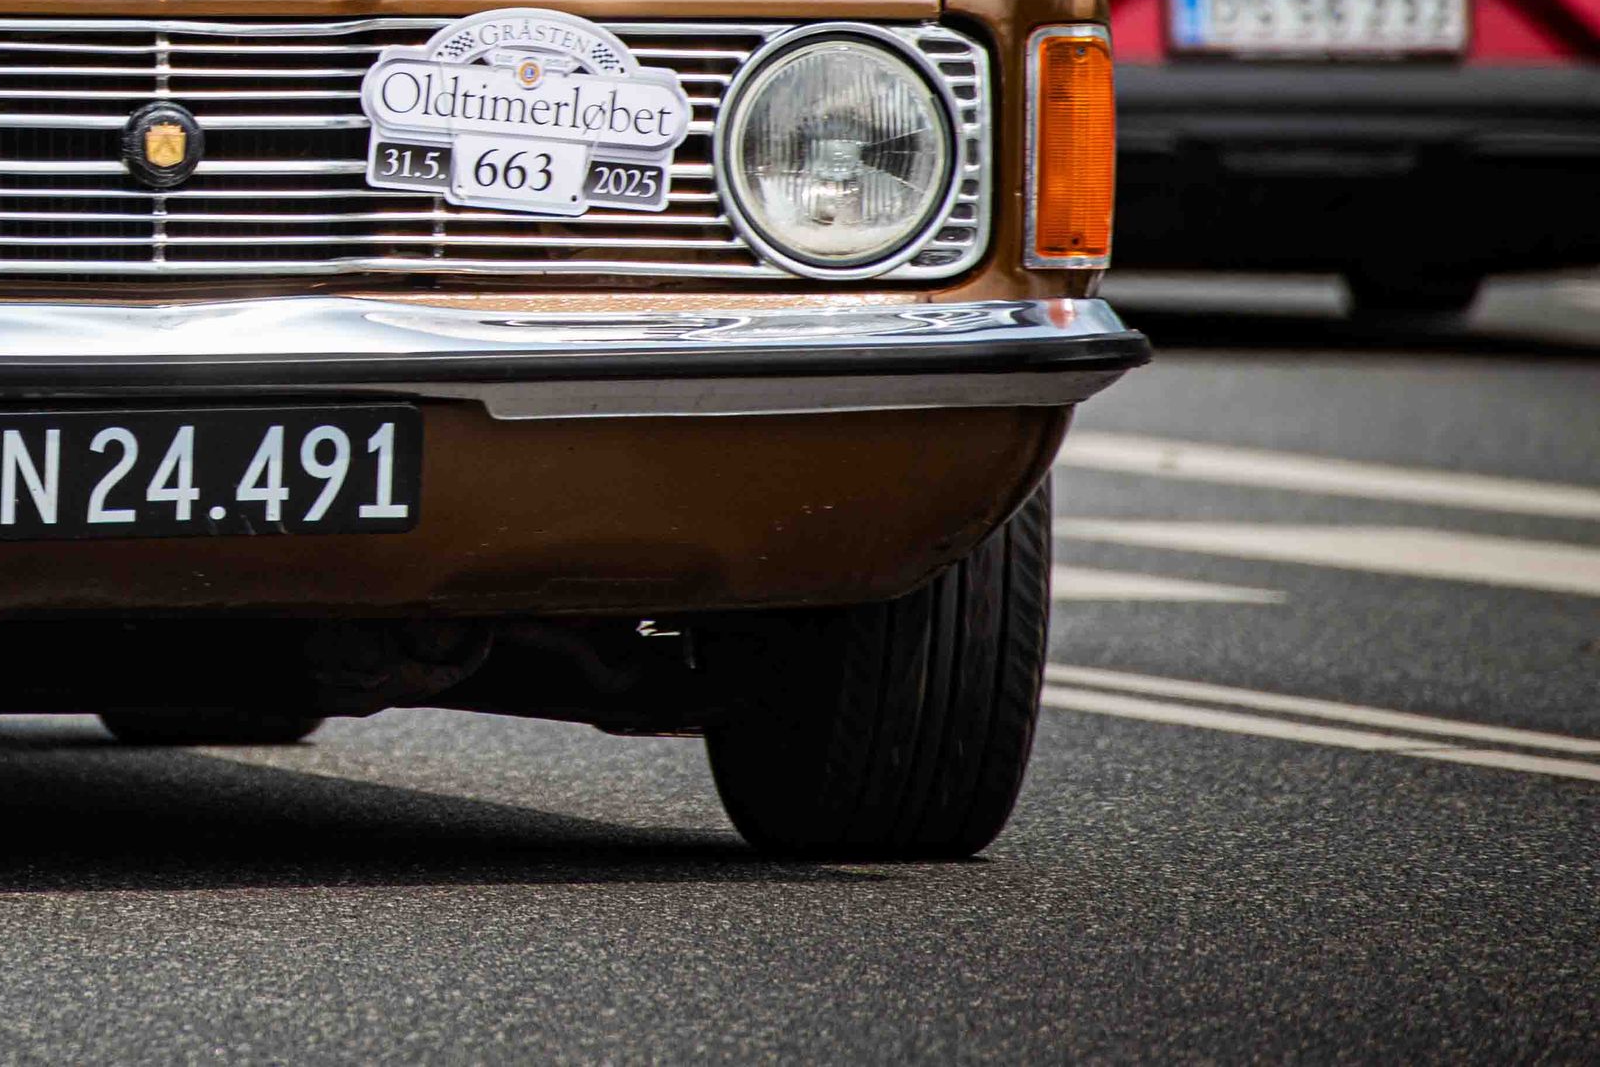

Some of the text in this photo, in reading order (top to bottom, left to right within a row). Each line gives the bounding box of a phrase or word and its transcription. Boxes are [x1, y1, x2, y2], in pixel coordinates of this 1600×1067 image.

[479, 19, 592, 54] GRÅSTEN
[381, 71, 673, 137] Oldtimerløbet
[380, 148, 446, 180] 31.5.
[474, 148, 553, 192] 663
[593, 166, 659, 198] 2025
[87, 422, 409, 523] 24.491
